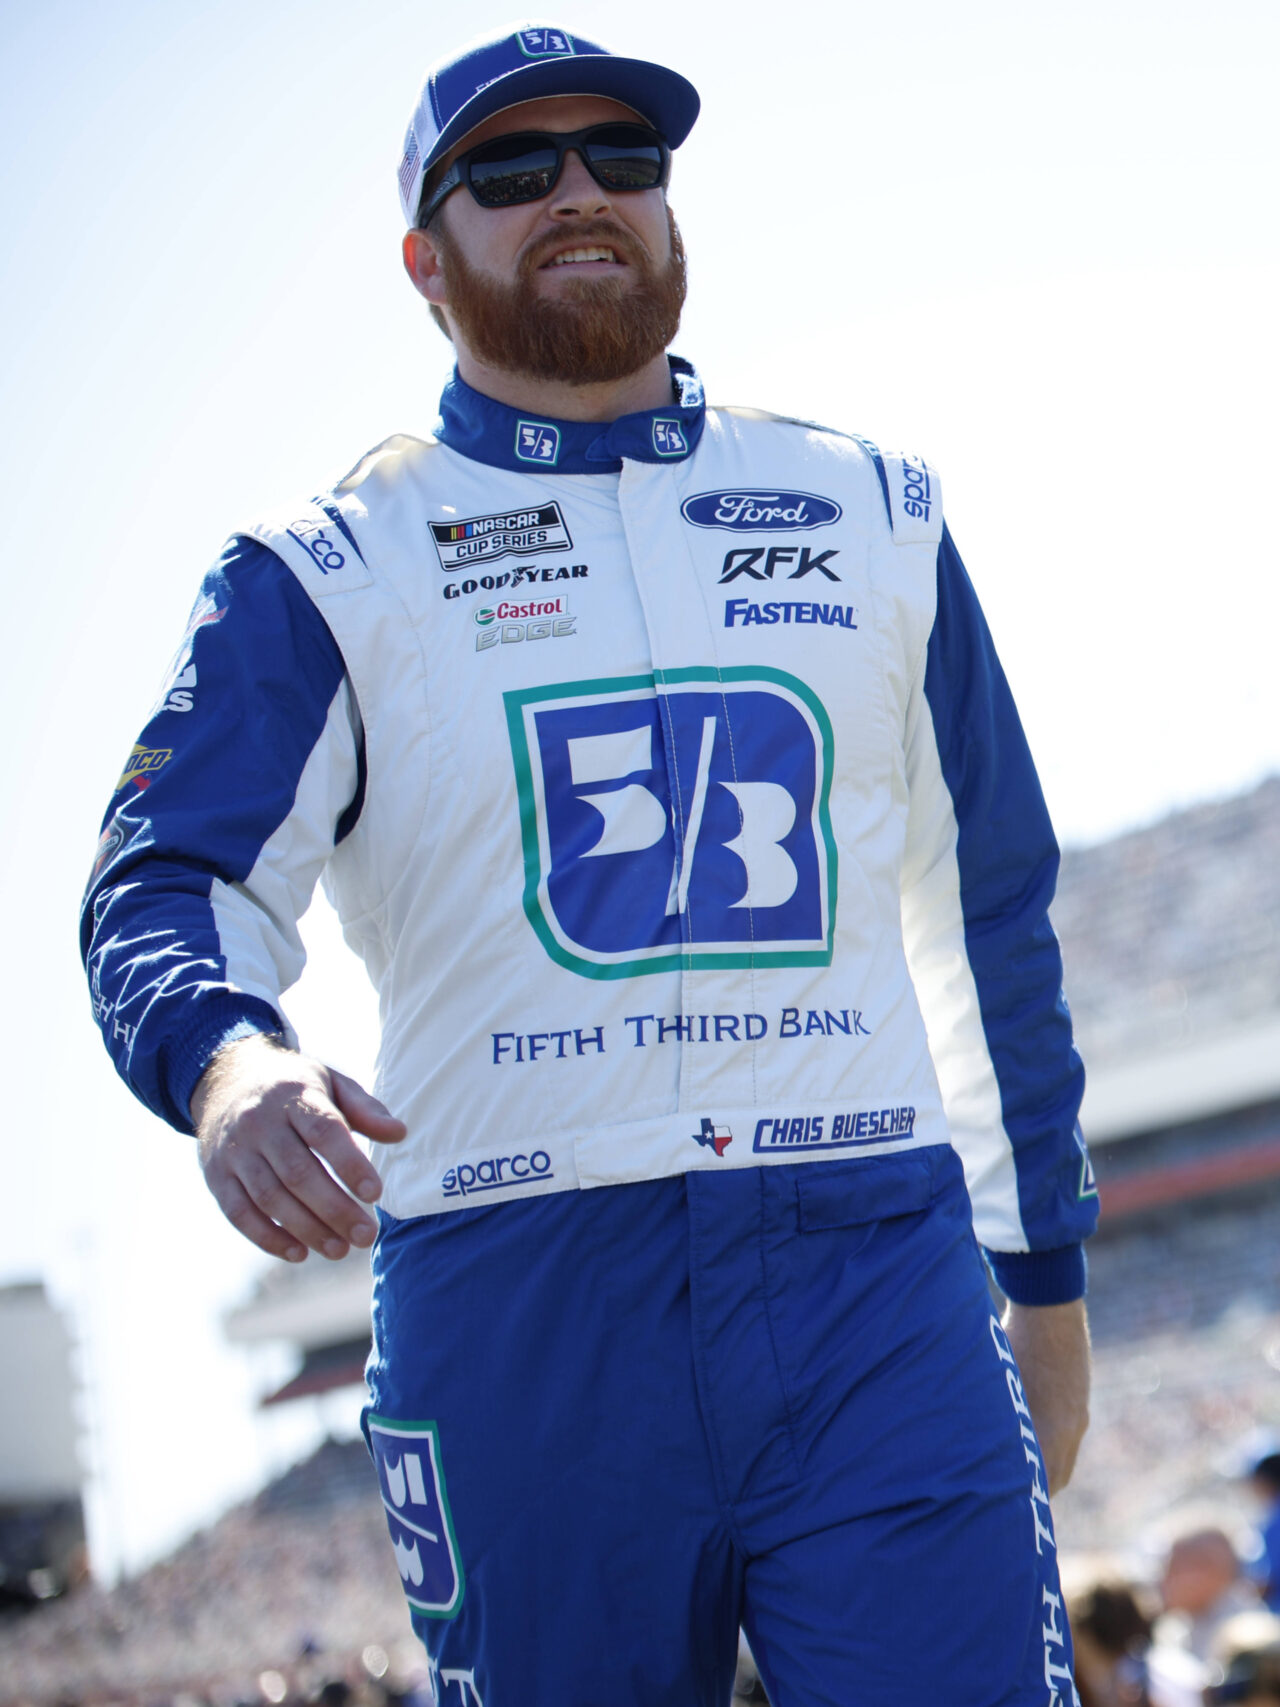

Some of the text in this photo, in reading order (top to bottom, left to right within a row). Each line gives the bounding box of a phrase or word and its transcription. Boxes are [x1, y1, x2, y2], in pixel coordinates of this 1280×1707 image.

[472, 512, 540, 536] NASCAR
[715, 495, 809, 523] Ford
[456, 530, 548, 558] CUP SERIES
[443, 564, 589, 600] GOODYEAR
[717, 547, 842, 584] RFK
[497, 598, 562, 619] Castrol
[724, 598, 858, 630] FASTENAL
[476, 616, 577, 652] EDGE
[491, 1008, 871, 1064] FIFTH THIRD BANK
[752, 1106, 916, 1153] CHRIS BUESCHER
[441, 1150, 551, 1197] sparco
[989, 1314, 1056, 1556] THIRD
